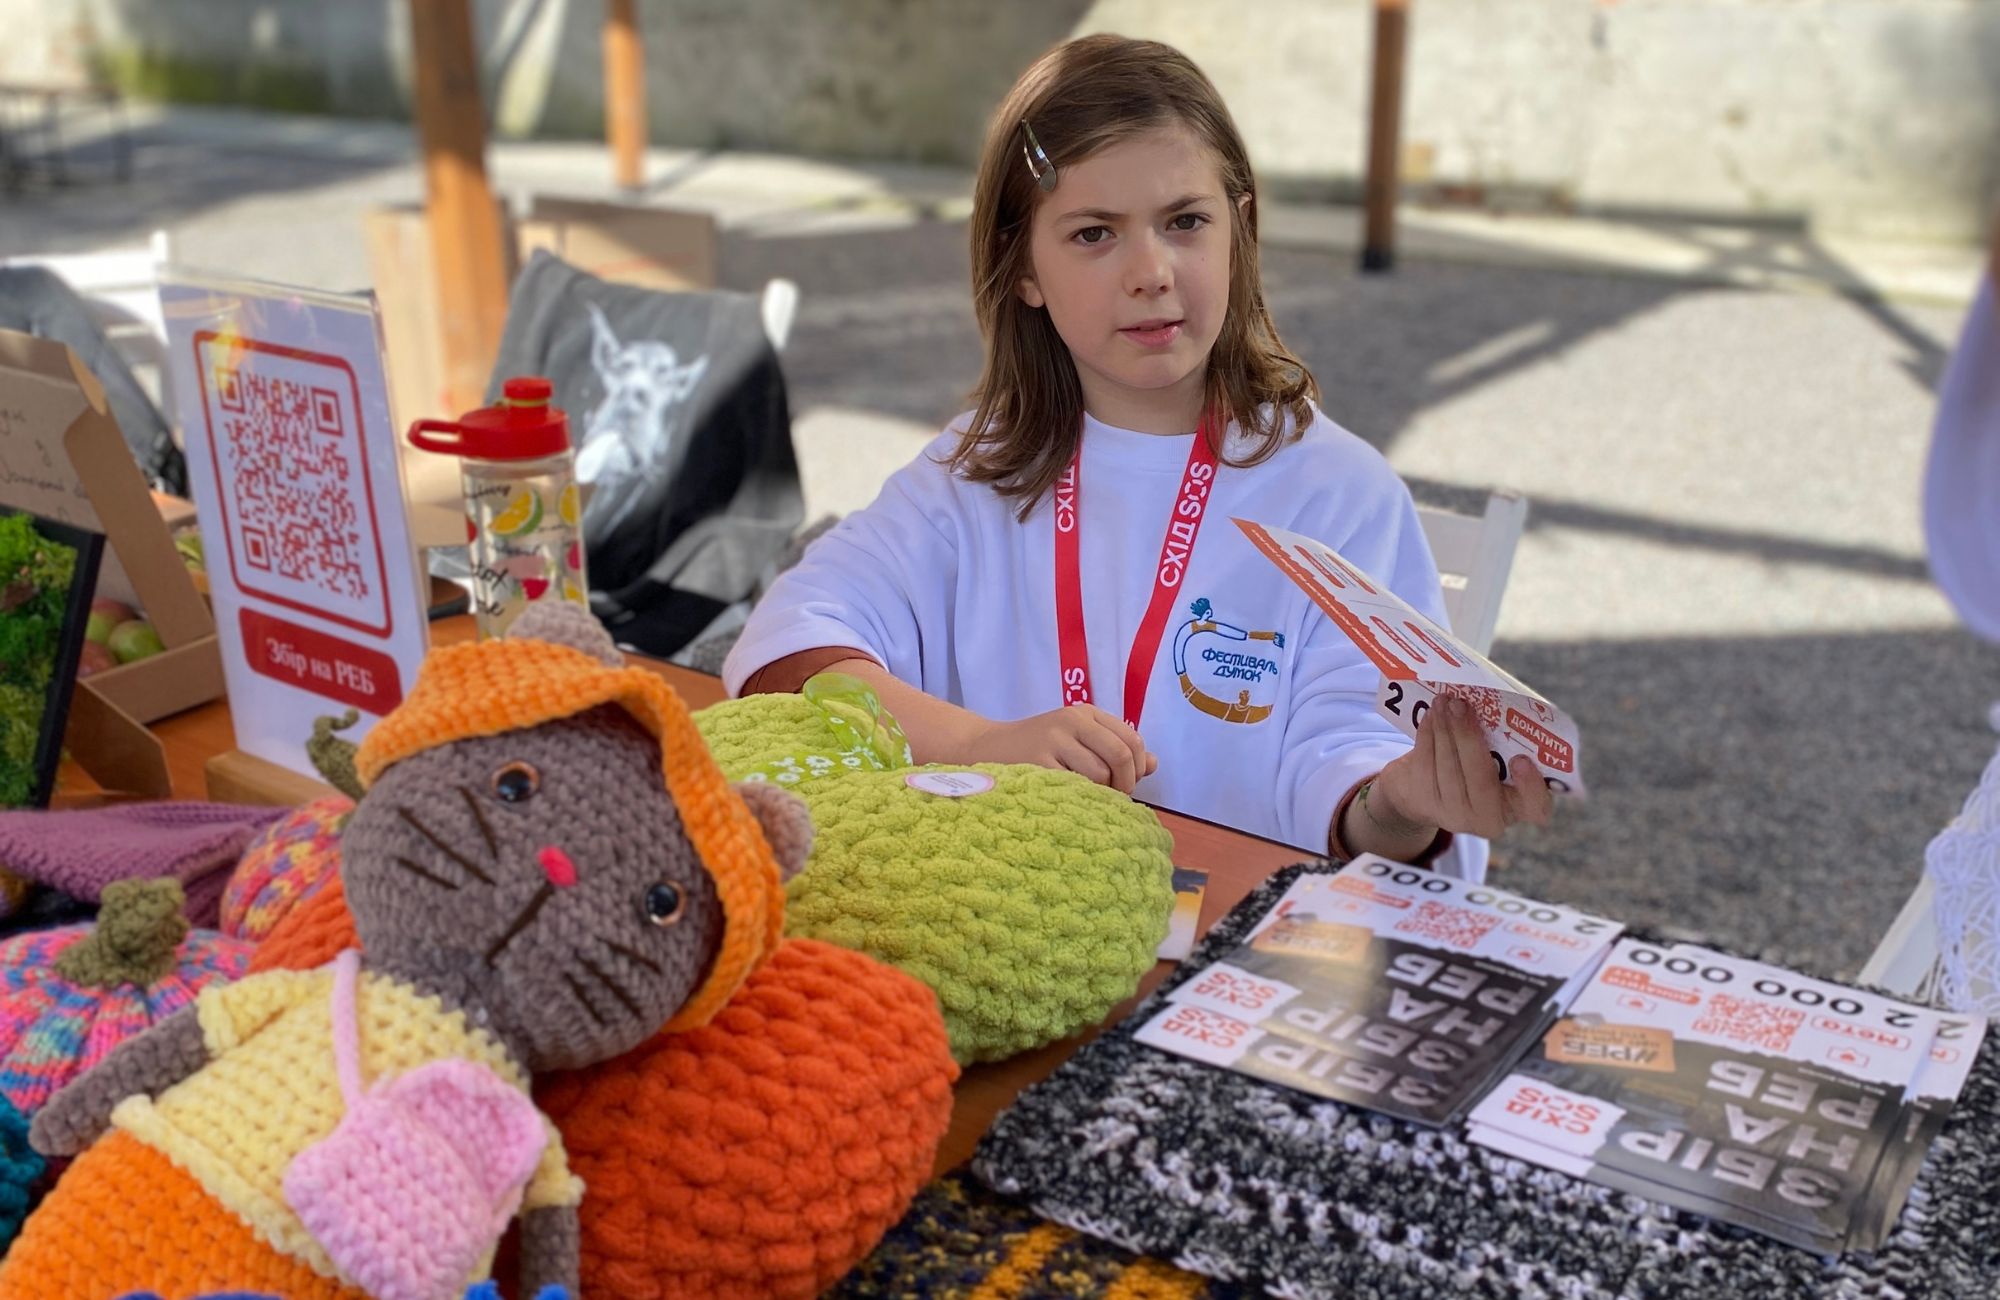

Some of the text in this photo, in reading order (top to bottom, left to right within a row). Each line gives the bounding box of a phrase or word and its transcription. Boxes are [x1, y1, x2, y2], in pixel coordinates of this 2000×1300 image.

[1160, 460, 1213, 588] СХІД SOS
[266, 637, 375, 696] Збір на РЕБ
[1202, 647, 1278, 675] ФЕСТИВАЛЬ
[1213, 665, 1262, 683] ДУМОК
[1064, 667, 1088, 706] OS
[1384, 681, 1404, 716] 2
[1511, 714, 1568, 756] ДОНАТИТИ
[1544, 752, 1568, 769] ТУТ
[1361, 861, 1452, 893] 000
[1465, 889, 1561, 924] 000
[1574, 918, 1609, 936] 2
[1193, 982, 1264, 1010] СХІД
[1206, 971, 1279, 1000] SOS
[1385, 952, 1539, 1016] РЕБ
[1628, 948, 1919, 1029] 2 000 000
[1161, 1017, 1237, 1049] СХІД
[1176, 1006, 1250, 1037] SOS
[1387, 987, 1505, 1047] НА
[1936, 1018, 1970, 1041] 2
[1284, 1005, 1468, 1073] ЗБІР
[1259, 1043, 1452, 1108] ЗБІР
[1515, 1086, 1601, 1123] SOS
[1705, 1059, 1880, 1131] РЕБ
[1504, 1099, 1591, 1136] СХІД
[1724, 1102, 1861, 1172] НА
[1618, 1128, 1842, 1208] ЗБІР
